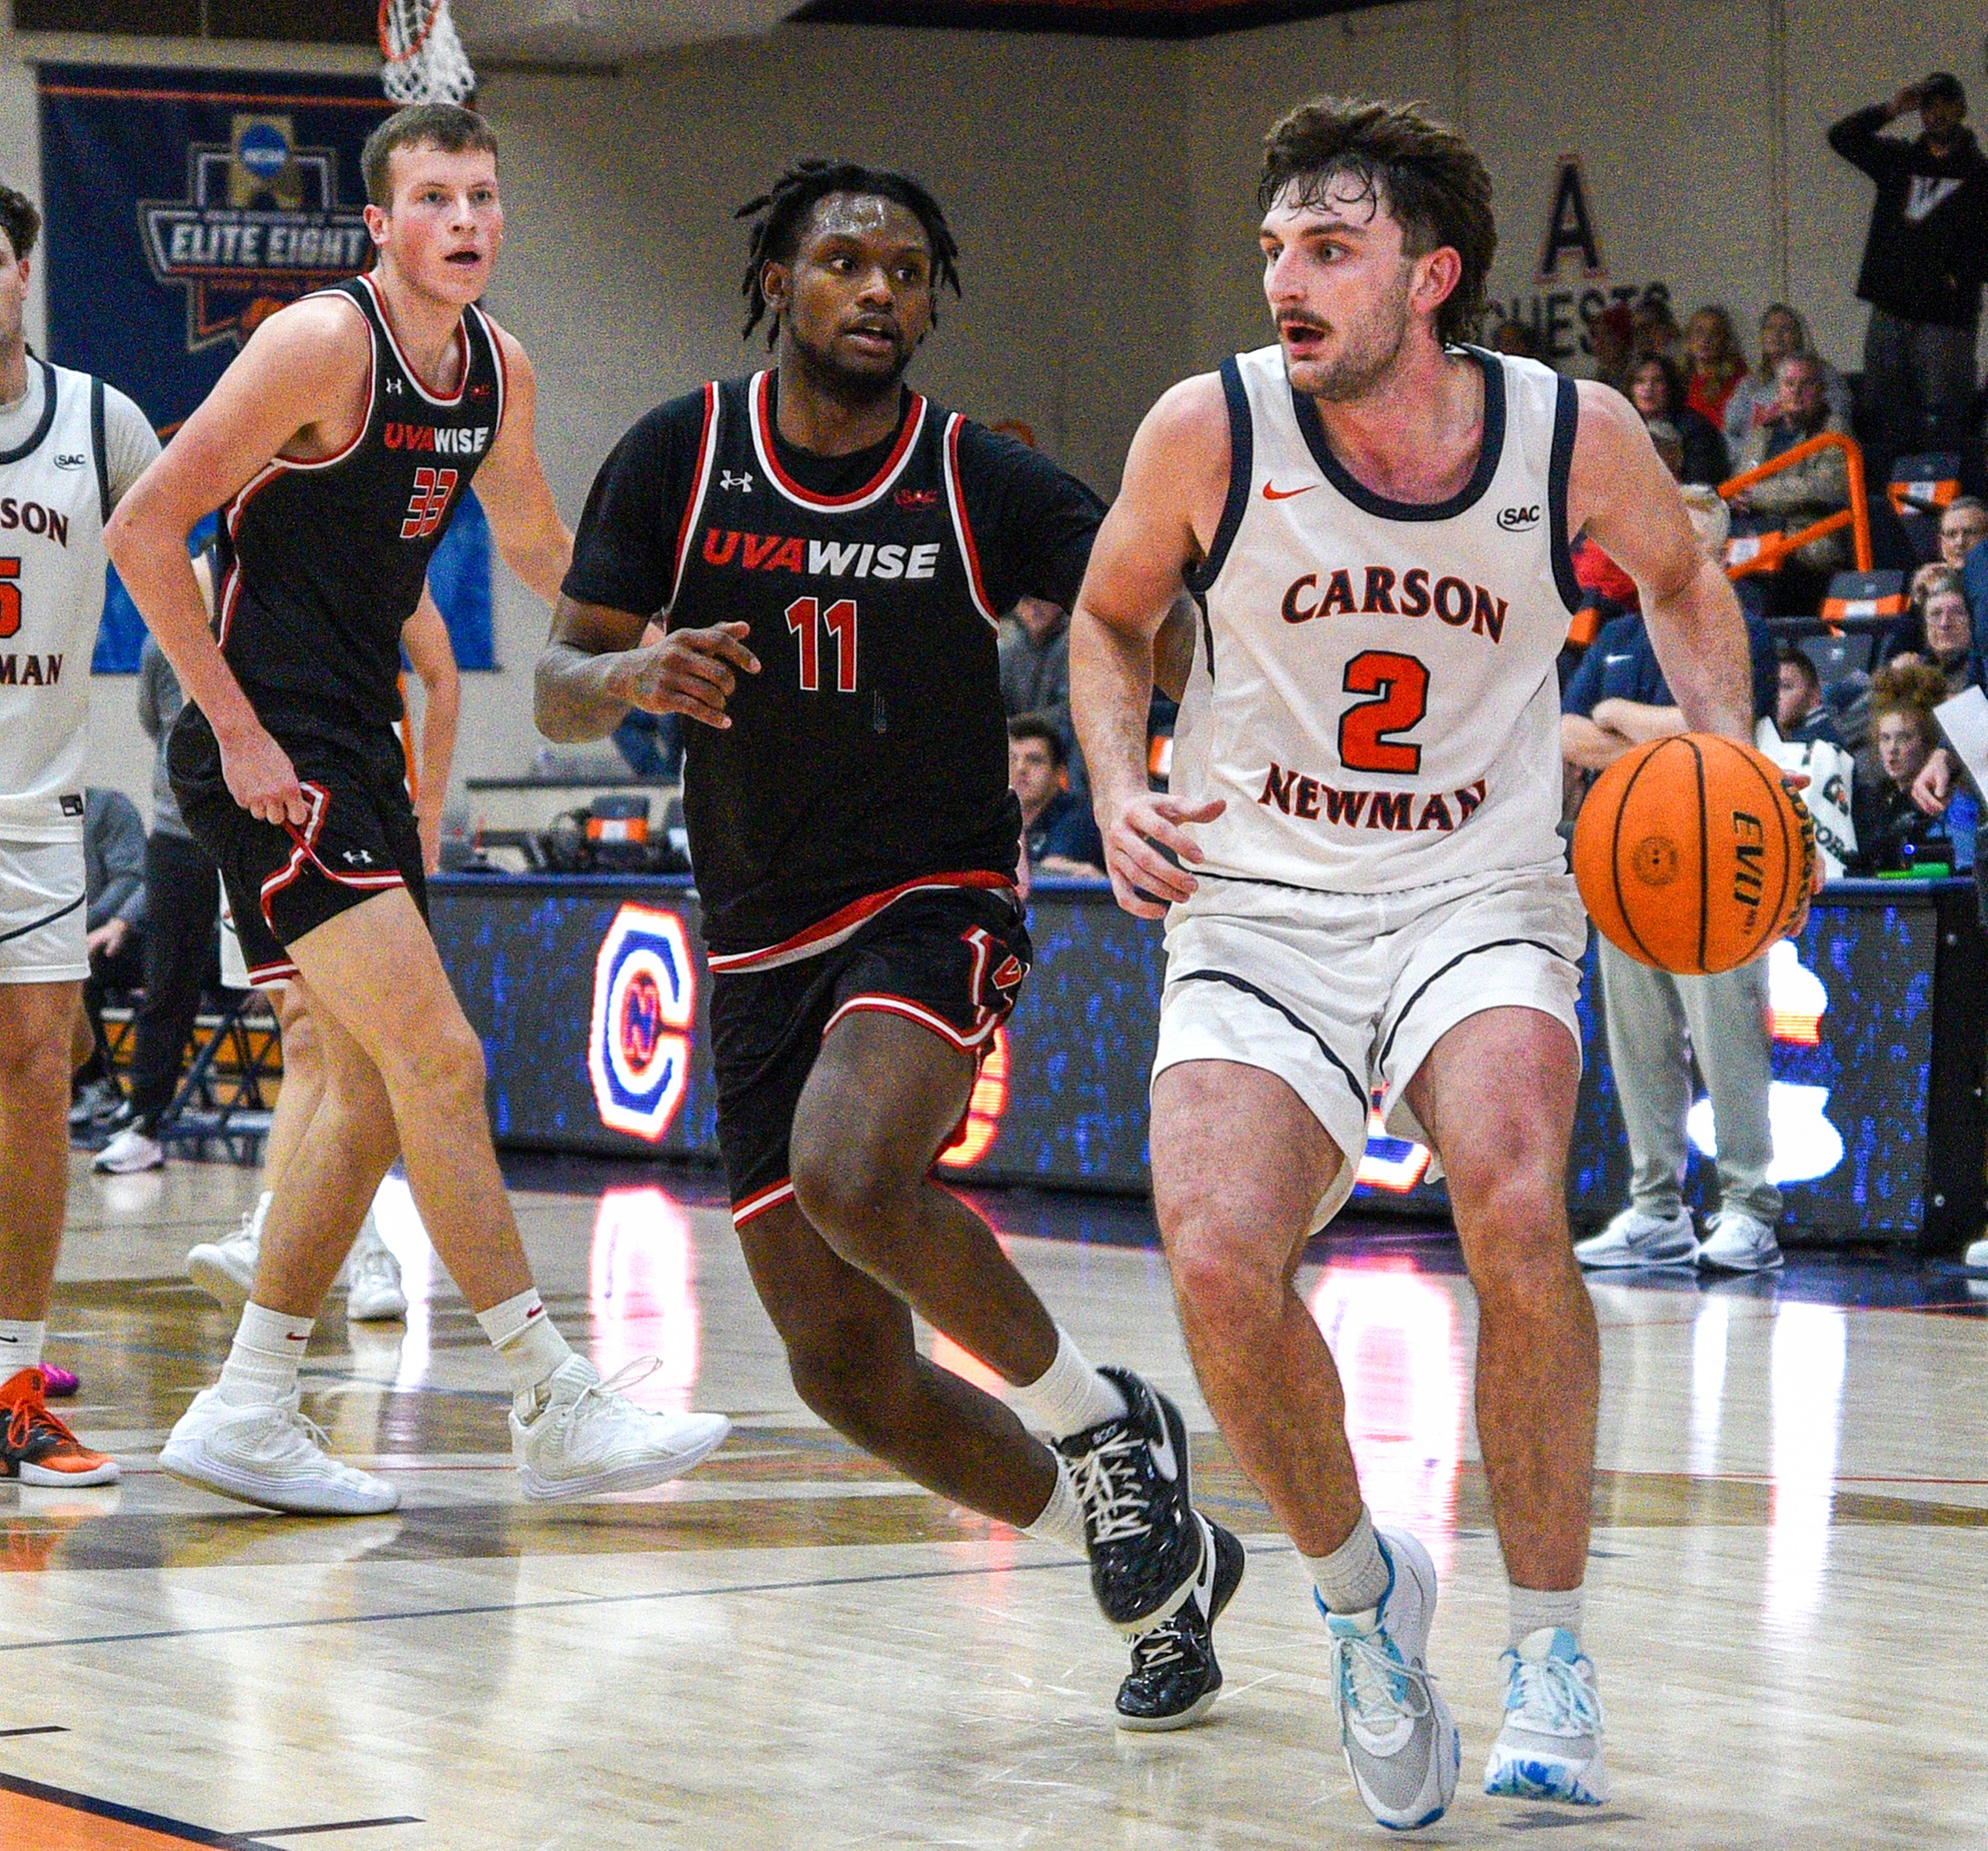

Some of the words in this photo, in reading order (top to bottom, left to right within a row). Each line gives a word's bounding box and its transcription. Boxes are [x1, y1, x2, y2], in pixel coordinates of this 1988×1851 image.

[171, 223, 262, 266] ELITE
[267, 225, 366, 267] EIGHT
[57, 454, 86, 466] SAC
[384, 422, 490, 454] UVAWISE
[400, 467, 459, 539] 33
[1502, 505, 1541, 526] SAC
[702, 528, 942, 580] UVAWISE
[1280, 566, 1509, 645] CARSON
[784, 596, 858, 693] 11
[1337, 650, 1430, 776] 2
[1257, 763, 1487, 832] NEWMAN
